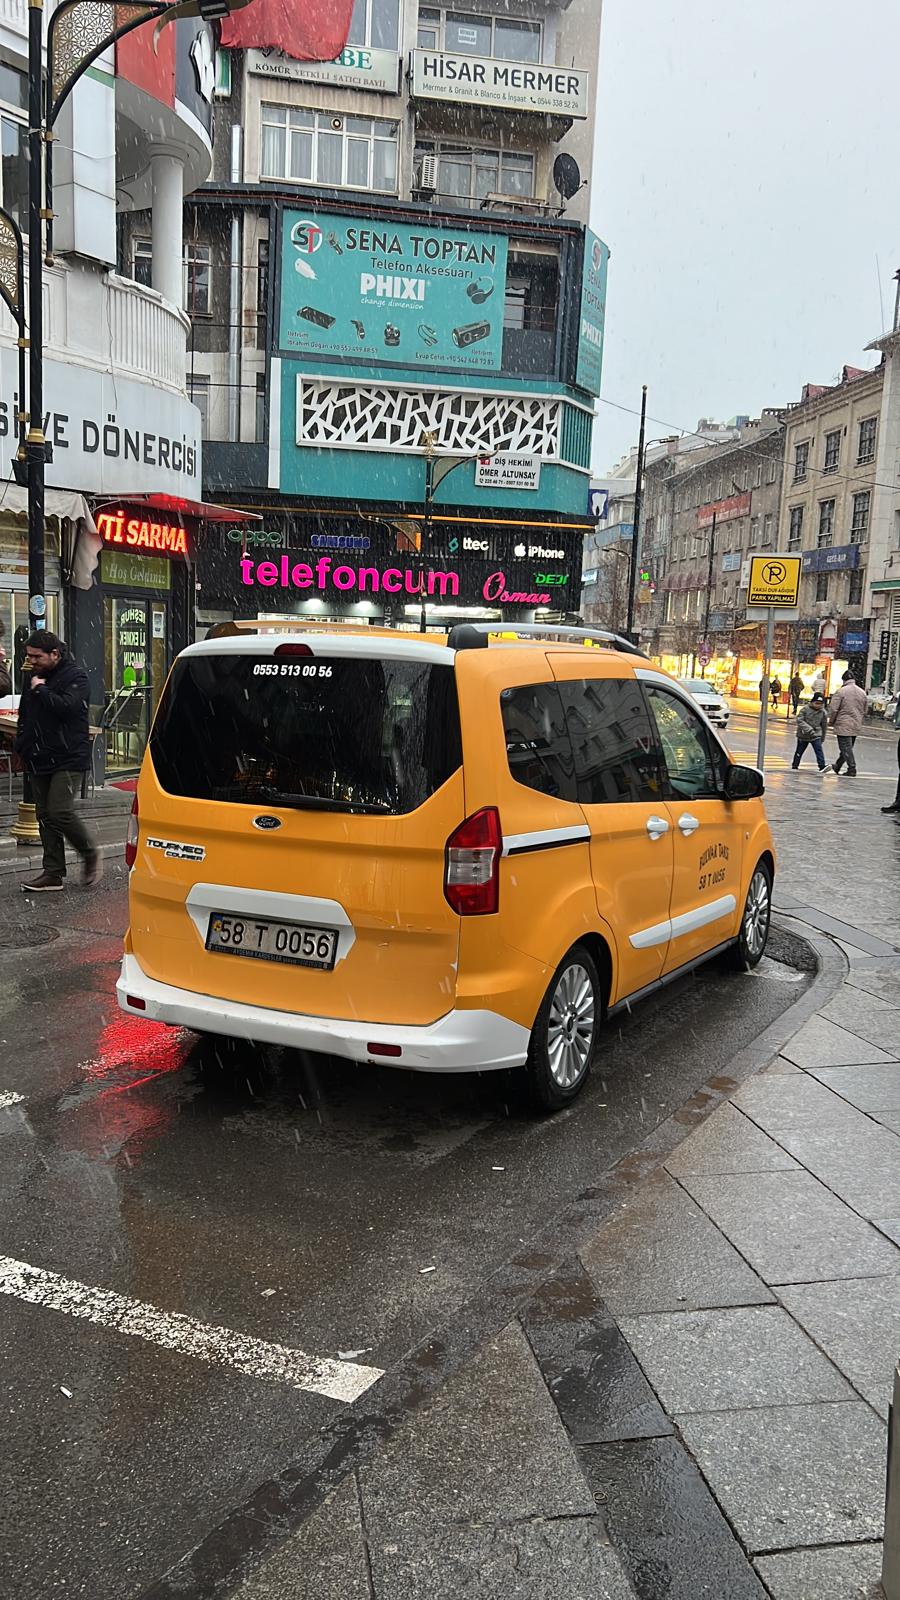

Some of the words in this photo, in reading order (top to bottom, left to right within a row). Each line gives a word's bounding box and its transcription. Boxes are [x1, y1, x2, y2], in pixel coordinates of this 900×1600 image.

[255, 63, 291, 75] KÖMÜR
[332, 74, 361, 85] SATICI
[423, 54, 486, 84] HİSAR
[493, 66, 580, 96] MERMER
[422, 82, 447, 93] Mermer
[454, 86, 473, 96] Granit
[480, 90, 500, 100] Blanco
[507, 92, 527, 104] İnşaat
[537, 97, 551, 106] 0544
[552, 98, 563, 107] 338
[563, 99, 571, 108] 52
[346, 228, 403, 256] SENA
[410, 236, 496, 265] TOPTAN
[370, 257, 413, 273] Telefon
[415, 263, 473, 279] Aksesuarı
[360, 273, 425, 301] PHIXI
[360, 297, 386, 307] change
[387, 299, 424, 310] dimension
[581, 318, 602, 347] PHIXI
[82, 413, 197, 478] DÖNERCİSİ
[479, 466, 499, 477] ÖMER
[501, 469, 537, 480] ALTUNSAY
[494, 457, 506, 466] DİŞ
[507, 458, 533, 467] HEKİMİ
[126, 519, 187, 553] SARMA
[310, 533, 371, 550] SAMSUNG
[462, 536, 490, 552] ttec
[528, 545, 565, 560] iPhone
[109, 563, 127, 584] Hoş
[130, 565, 166, 585] Geldiniz
[239, 554, 460, 597] telefoncum
[482, 571, 552, 604] Osman
[535, 573, 568, 585] DEJI
[767, 594, 795, 602] YAPILMAZ
[253, 664, 279, 676] 0553
[280, 664, 300, 676] 513
[302, 665, 317, 677] 00
[318, 665, 333, 678] 56
[259, 817, 276, 828] Ford
[146, 838, 204, 855] TOURNEO
[165, 850, 203, 861] COURIER
[699, 874, 706, 890] 58
[707, 873, 712, 887] T
[220, 920, 245, 945] 58
[255, 924, 269, 948] T
[275, 928, 331, 959] 0056
